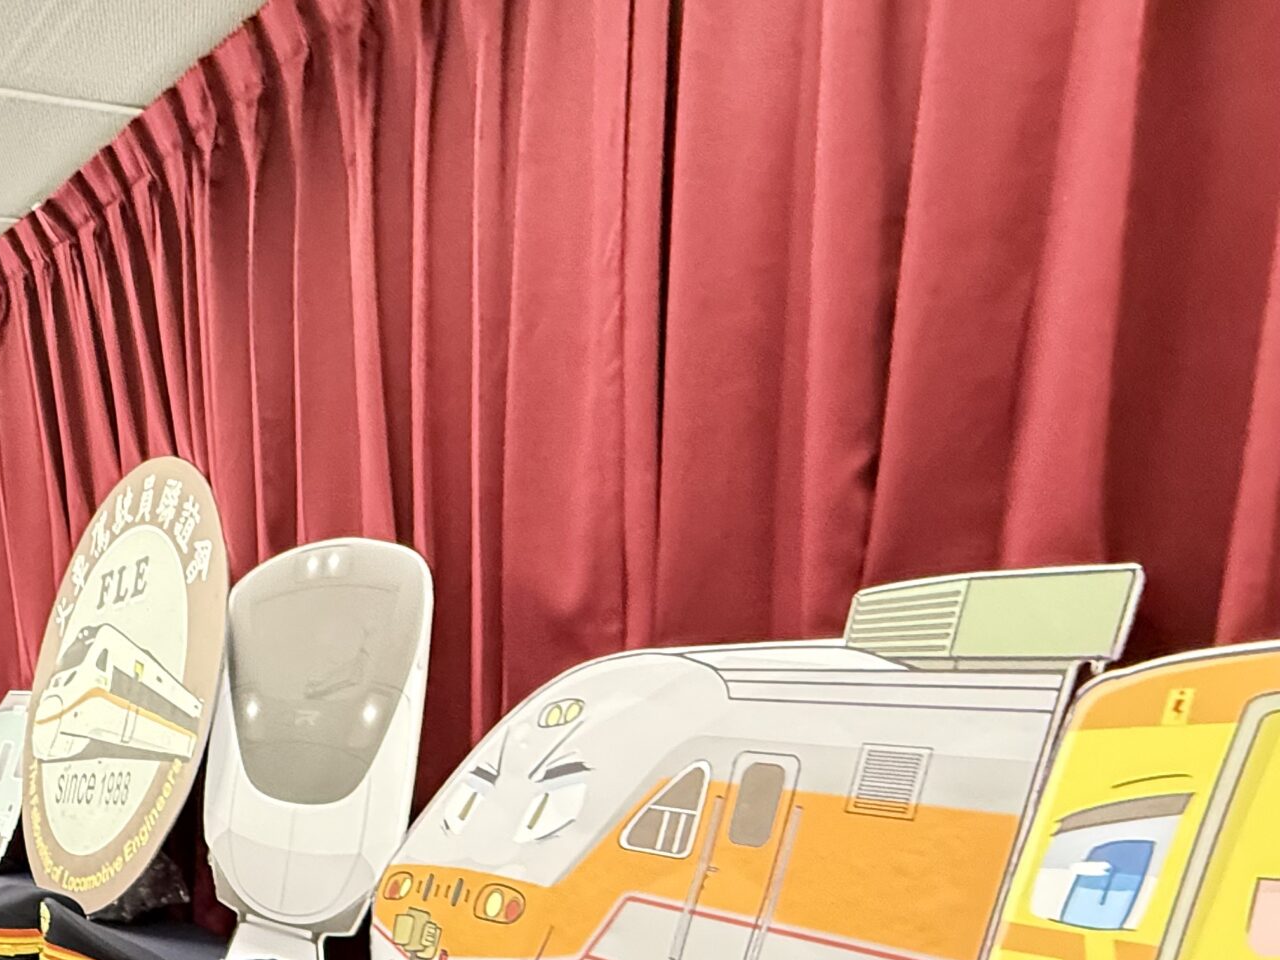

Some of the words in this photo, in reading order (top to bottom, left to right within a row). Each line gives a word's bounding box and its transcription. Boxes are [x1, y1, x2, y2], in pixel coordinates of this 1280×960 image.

[96, 555, 150, 610] FLE
[55, 766, 96, 805] since
[98, 771, 132, 807] 1988
[61, 856, 124, 893] Locomotive
[122, 758, 184, 862] Engineers
